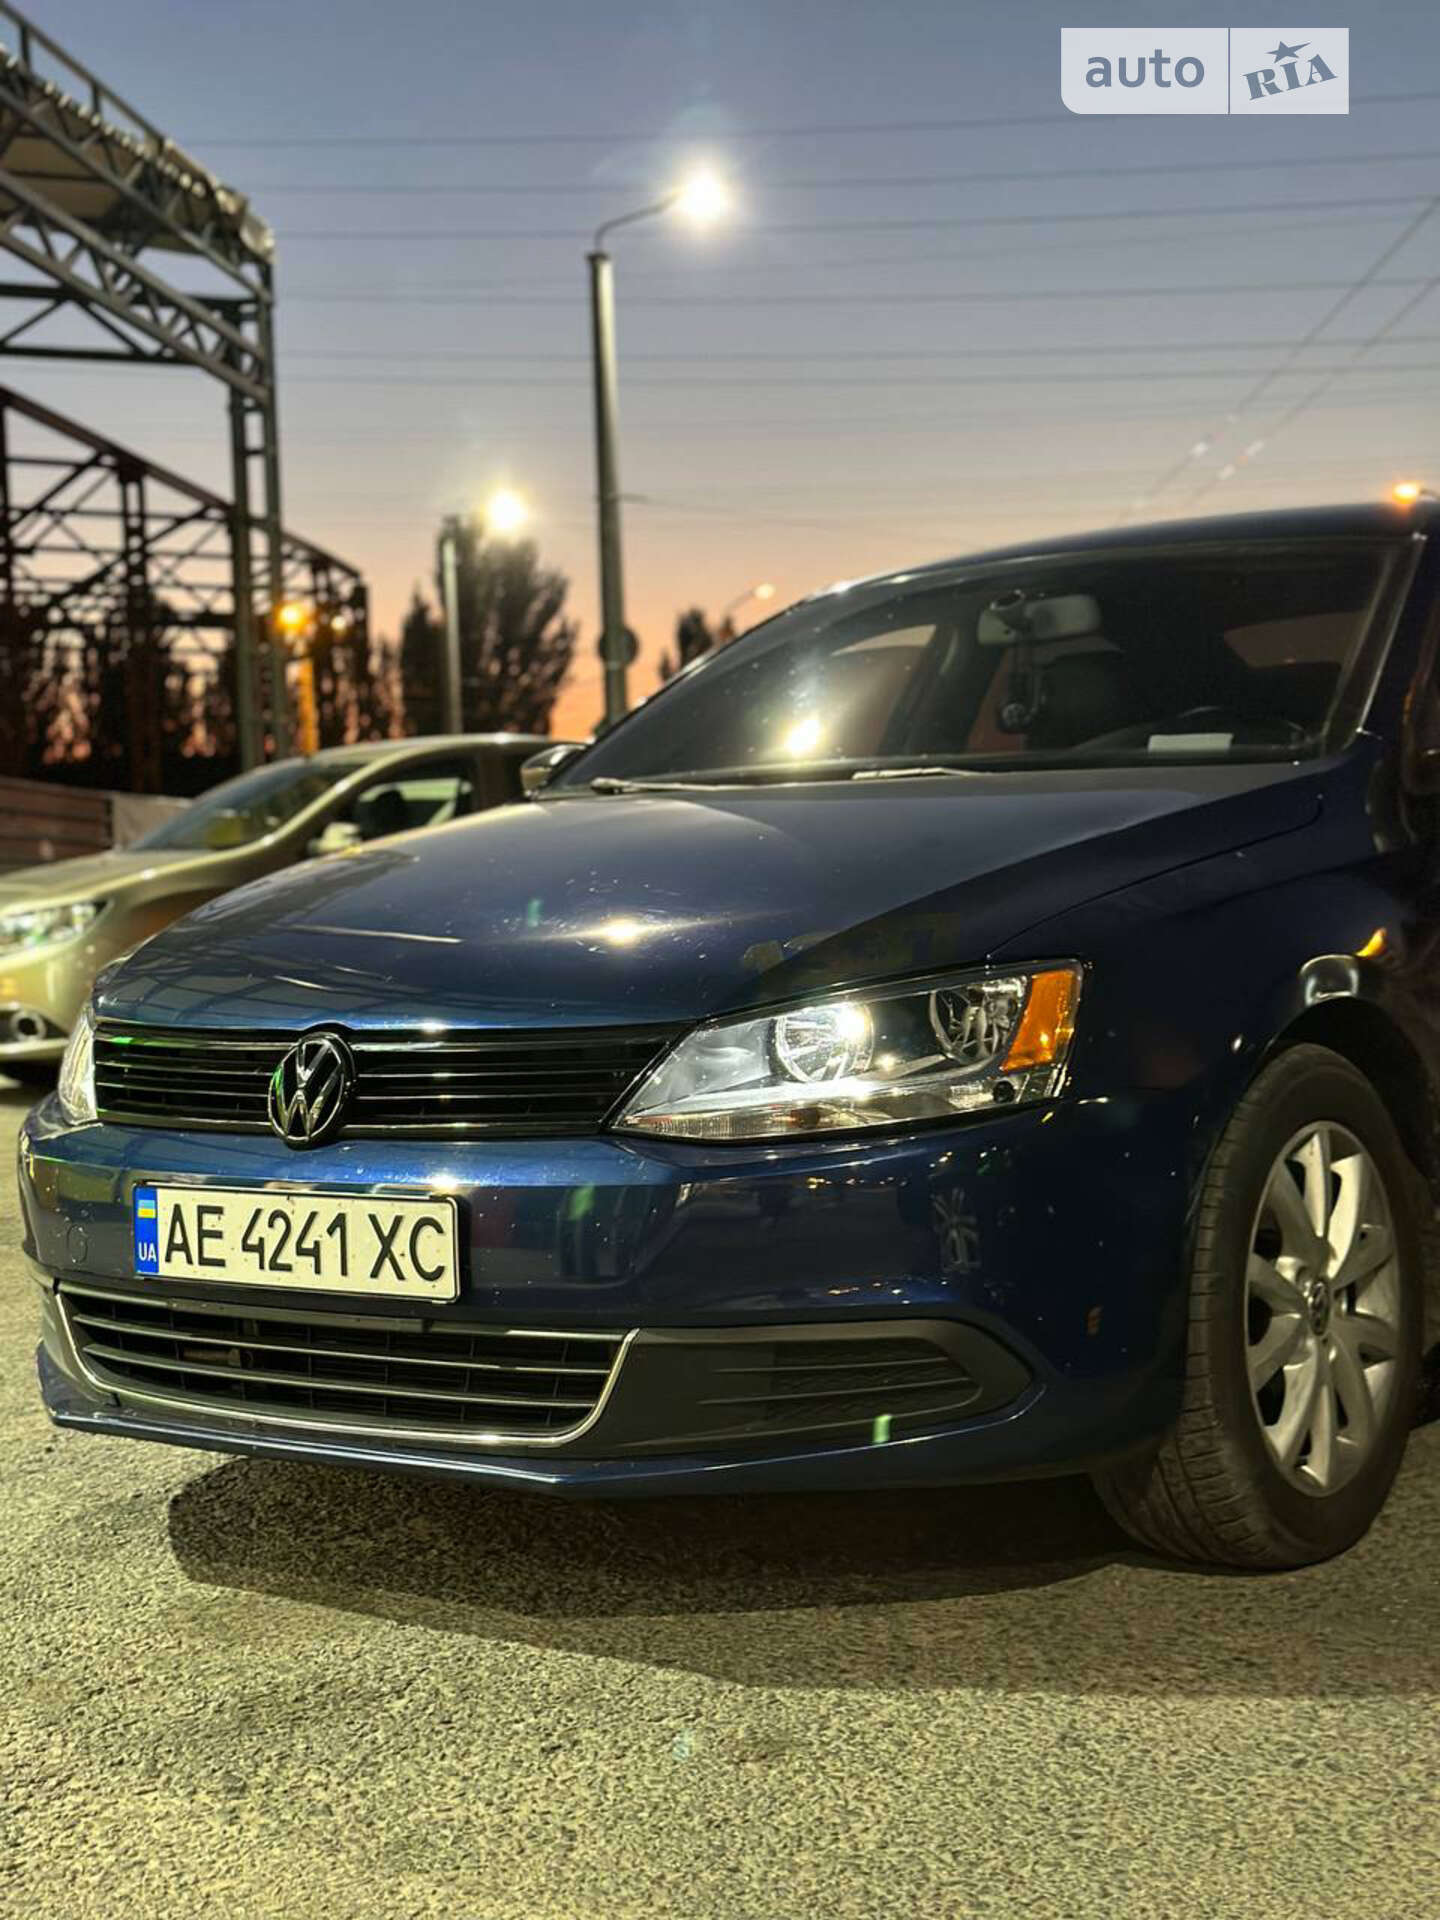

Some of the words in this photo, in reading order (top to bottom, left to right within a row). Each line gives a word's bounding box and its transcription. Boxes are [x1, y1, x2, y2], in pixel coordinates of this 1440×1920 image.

[138, 1241, 157, 1262] UA
[165, 1203, 226, 1268] AE
[241, 1208, 348, 1276] 4241
[368, 1213, 446, 1281] XC
